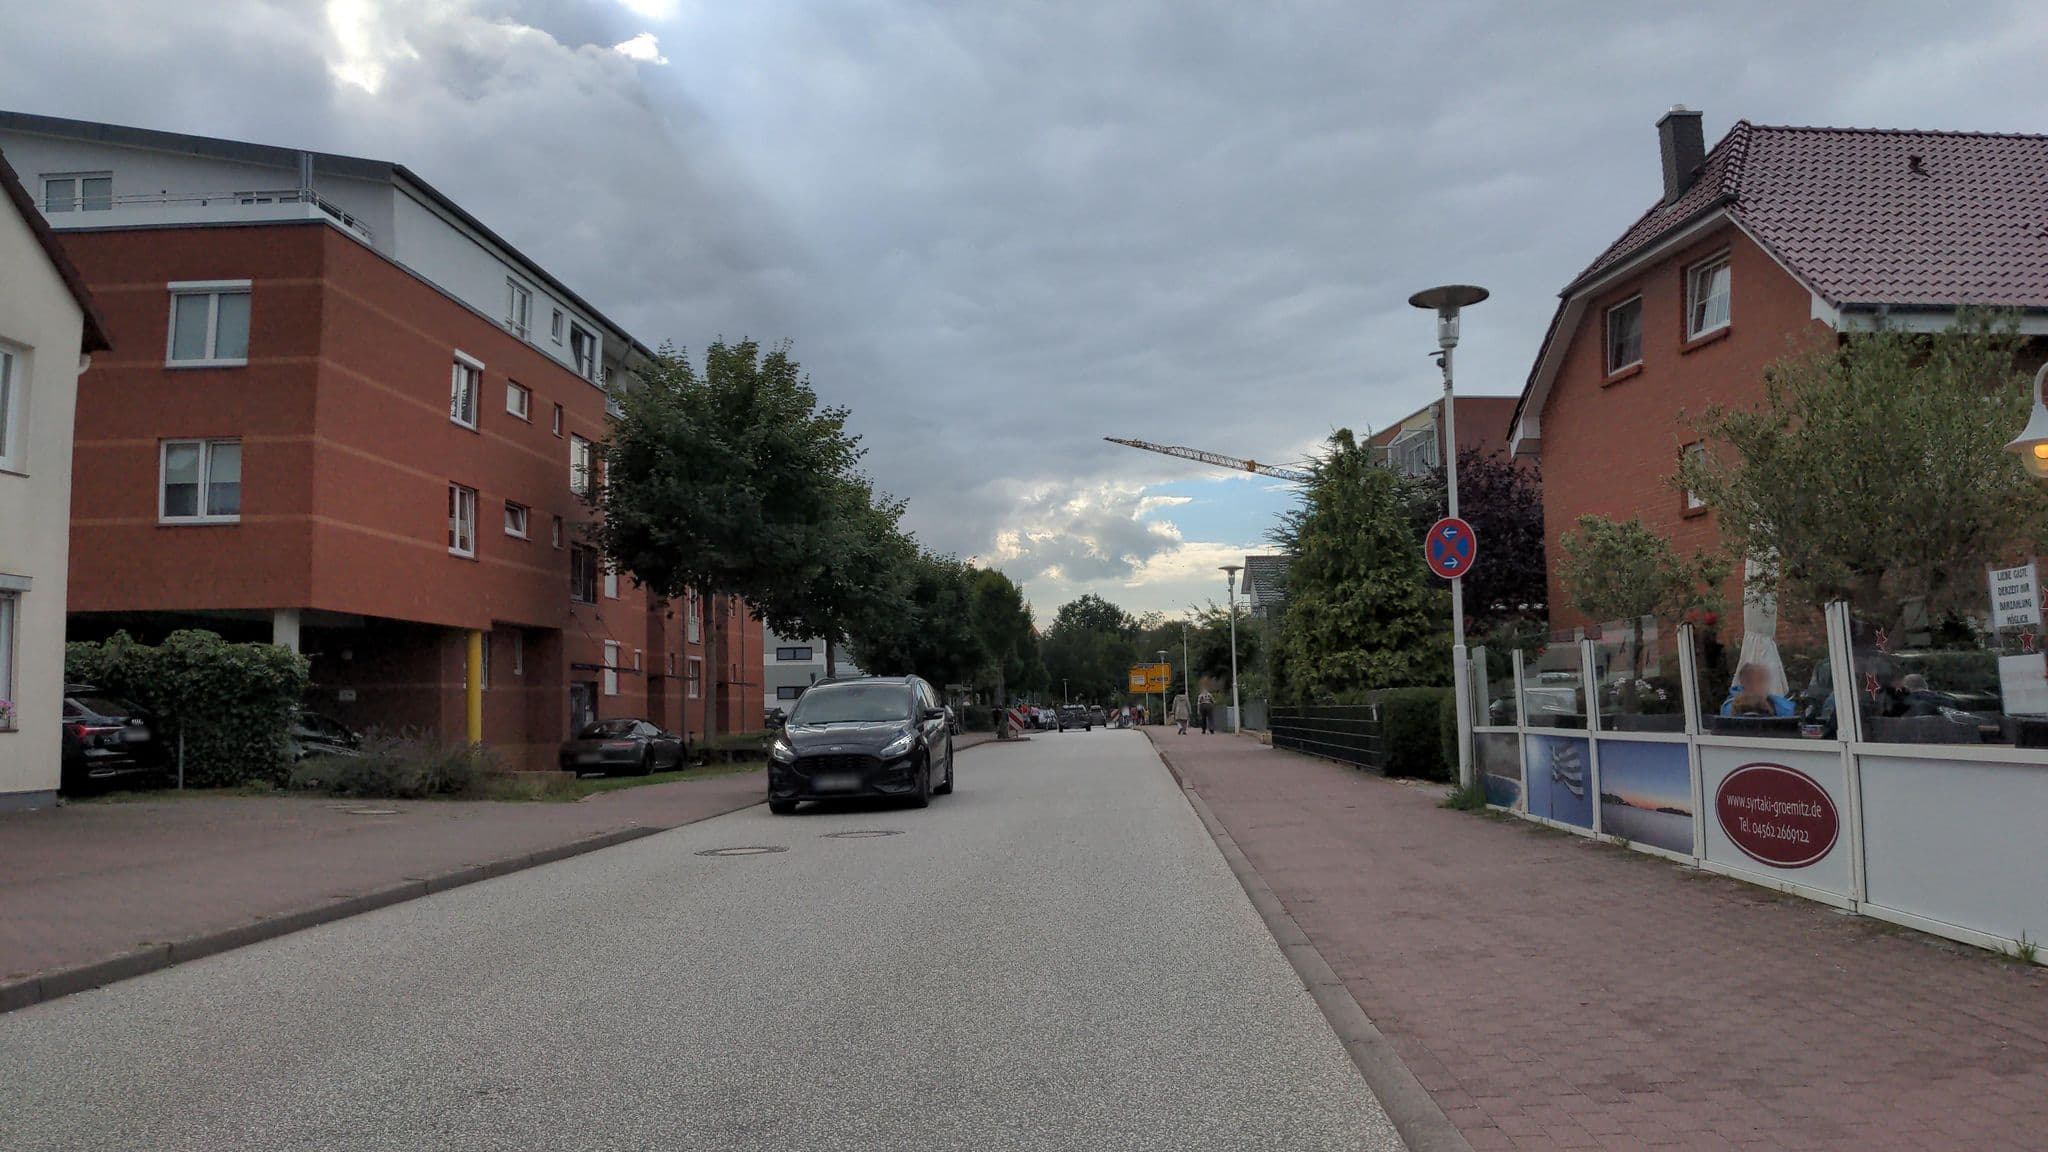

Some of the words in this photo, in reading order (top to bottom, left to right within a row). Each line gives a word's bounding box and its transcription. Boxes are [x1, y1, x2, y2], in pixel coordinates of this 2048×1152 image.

[1997, 571, 2012, 581] LIEBE
[1998, 585, 2019, 596] DERZEIT
[2000, 599, 2032, 611] BARZAHLUNG
[2007, 614, 2029, 624] MÖGLICH
[1726, 794, 1822, 818] www.syrtaki-groemitz.de
[1738, 816, 1751, 833] Tel.
[1752, 822, 1775, 839] 04562
[1776, 824, 1810, 844] 2669122
